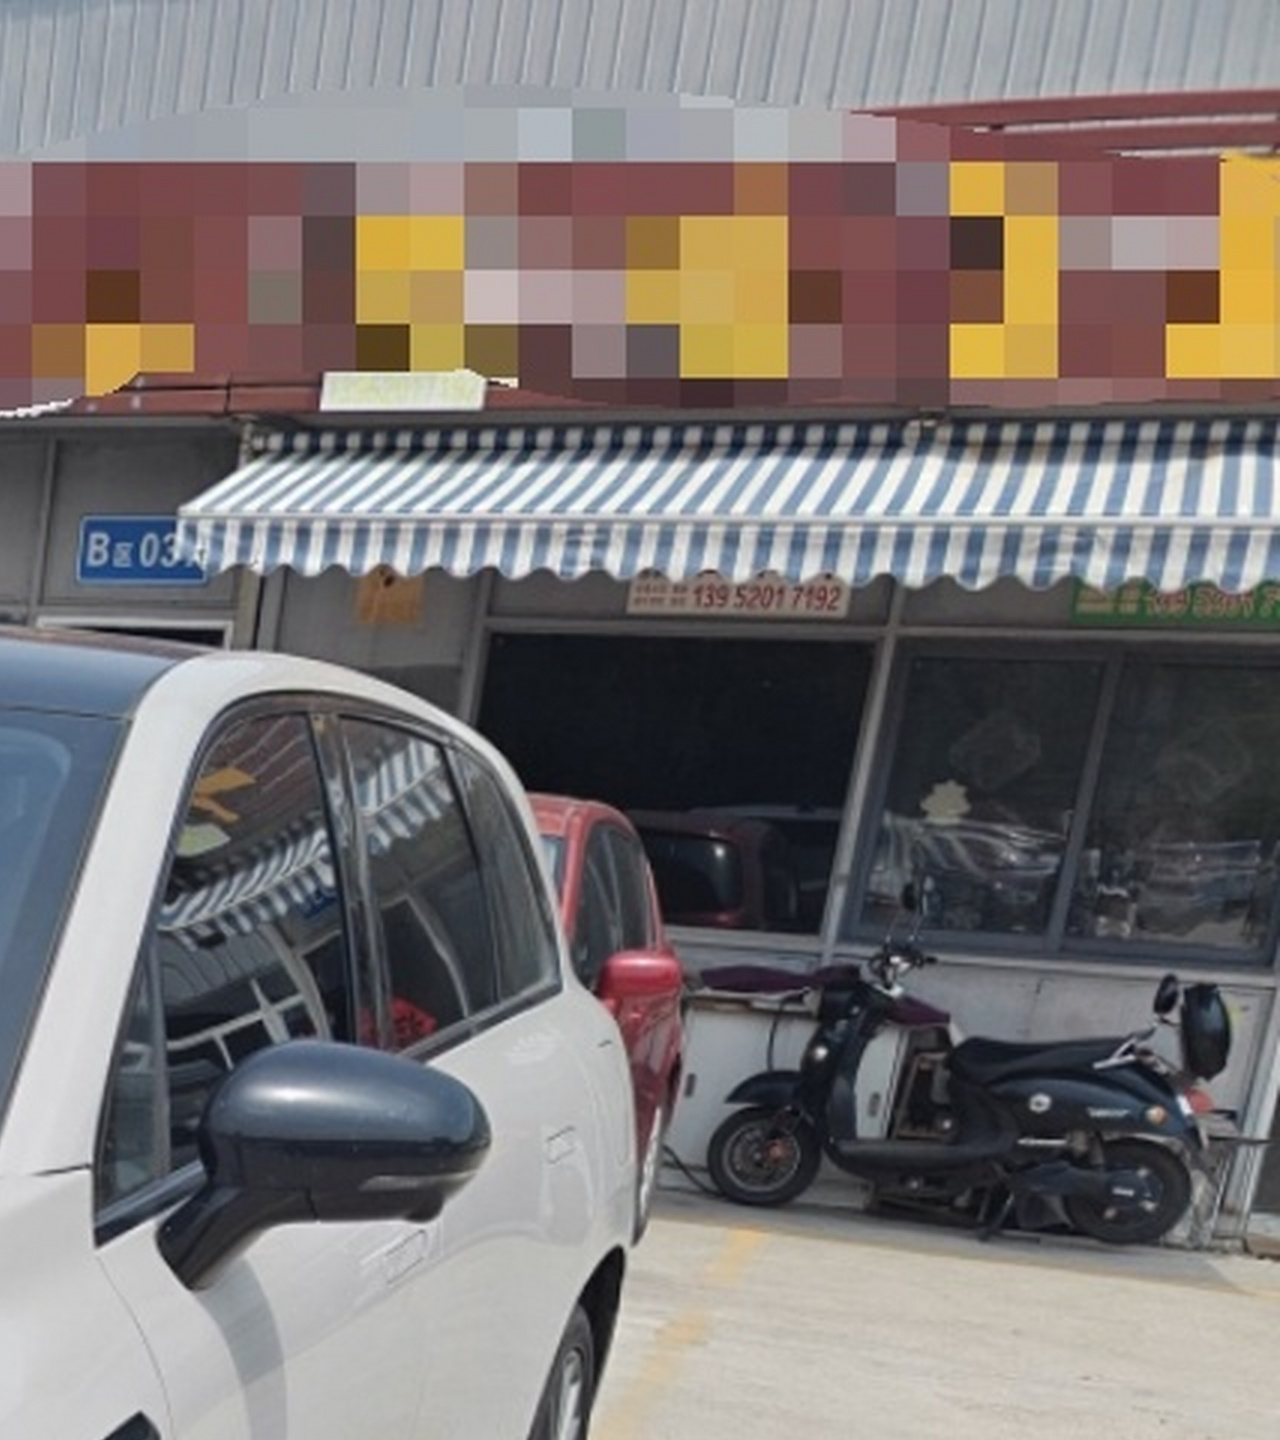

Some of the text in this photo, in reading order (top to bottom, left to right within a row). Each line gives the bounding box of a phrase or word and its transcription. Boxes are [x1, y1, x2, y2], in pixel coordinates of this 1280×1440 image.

[86, 531, 195, 568] B区03
[693, 584, 840, 611] 139 5201 7192
